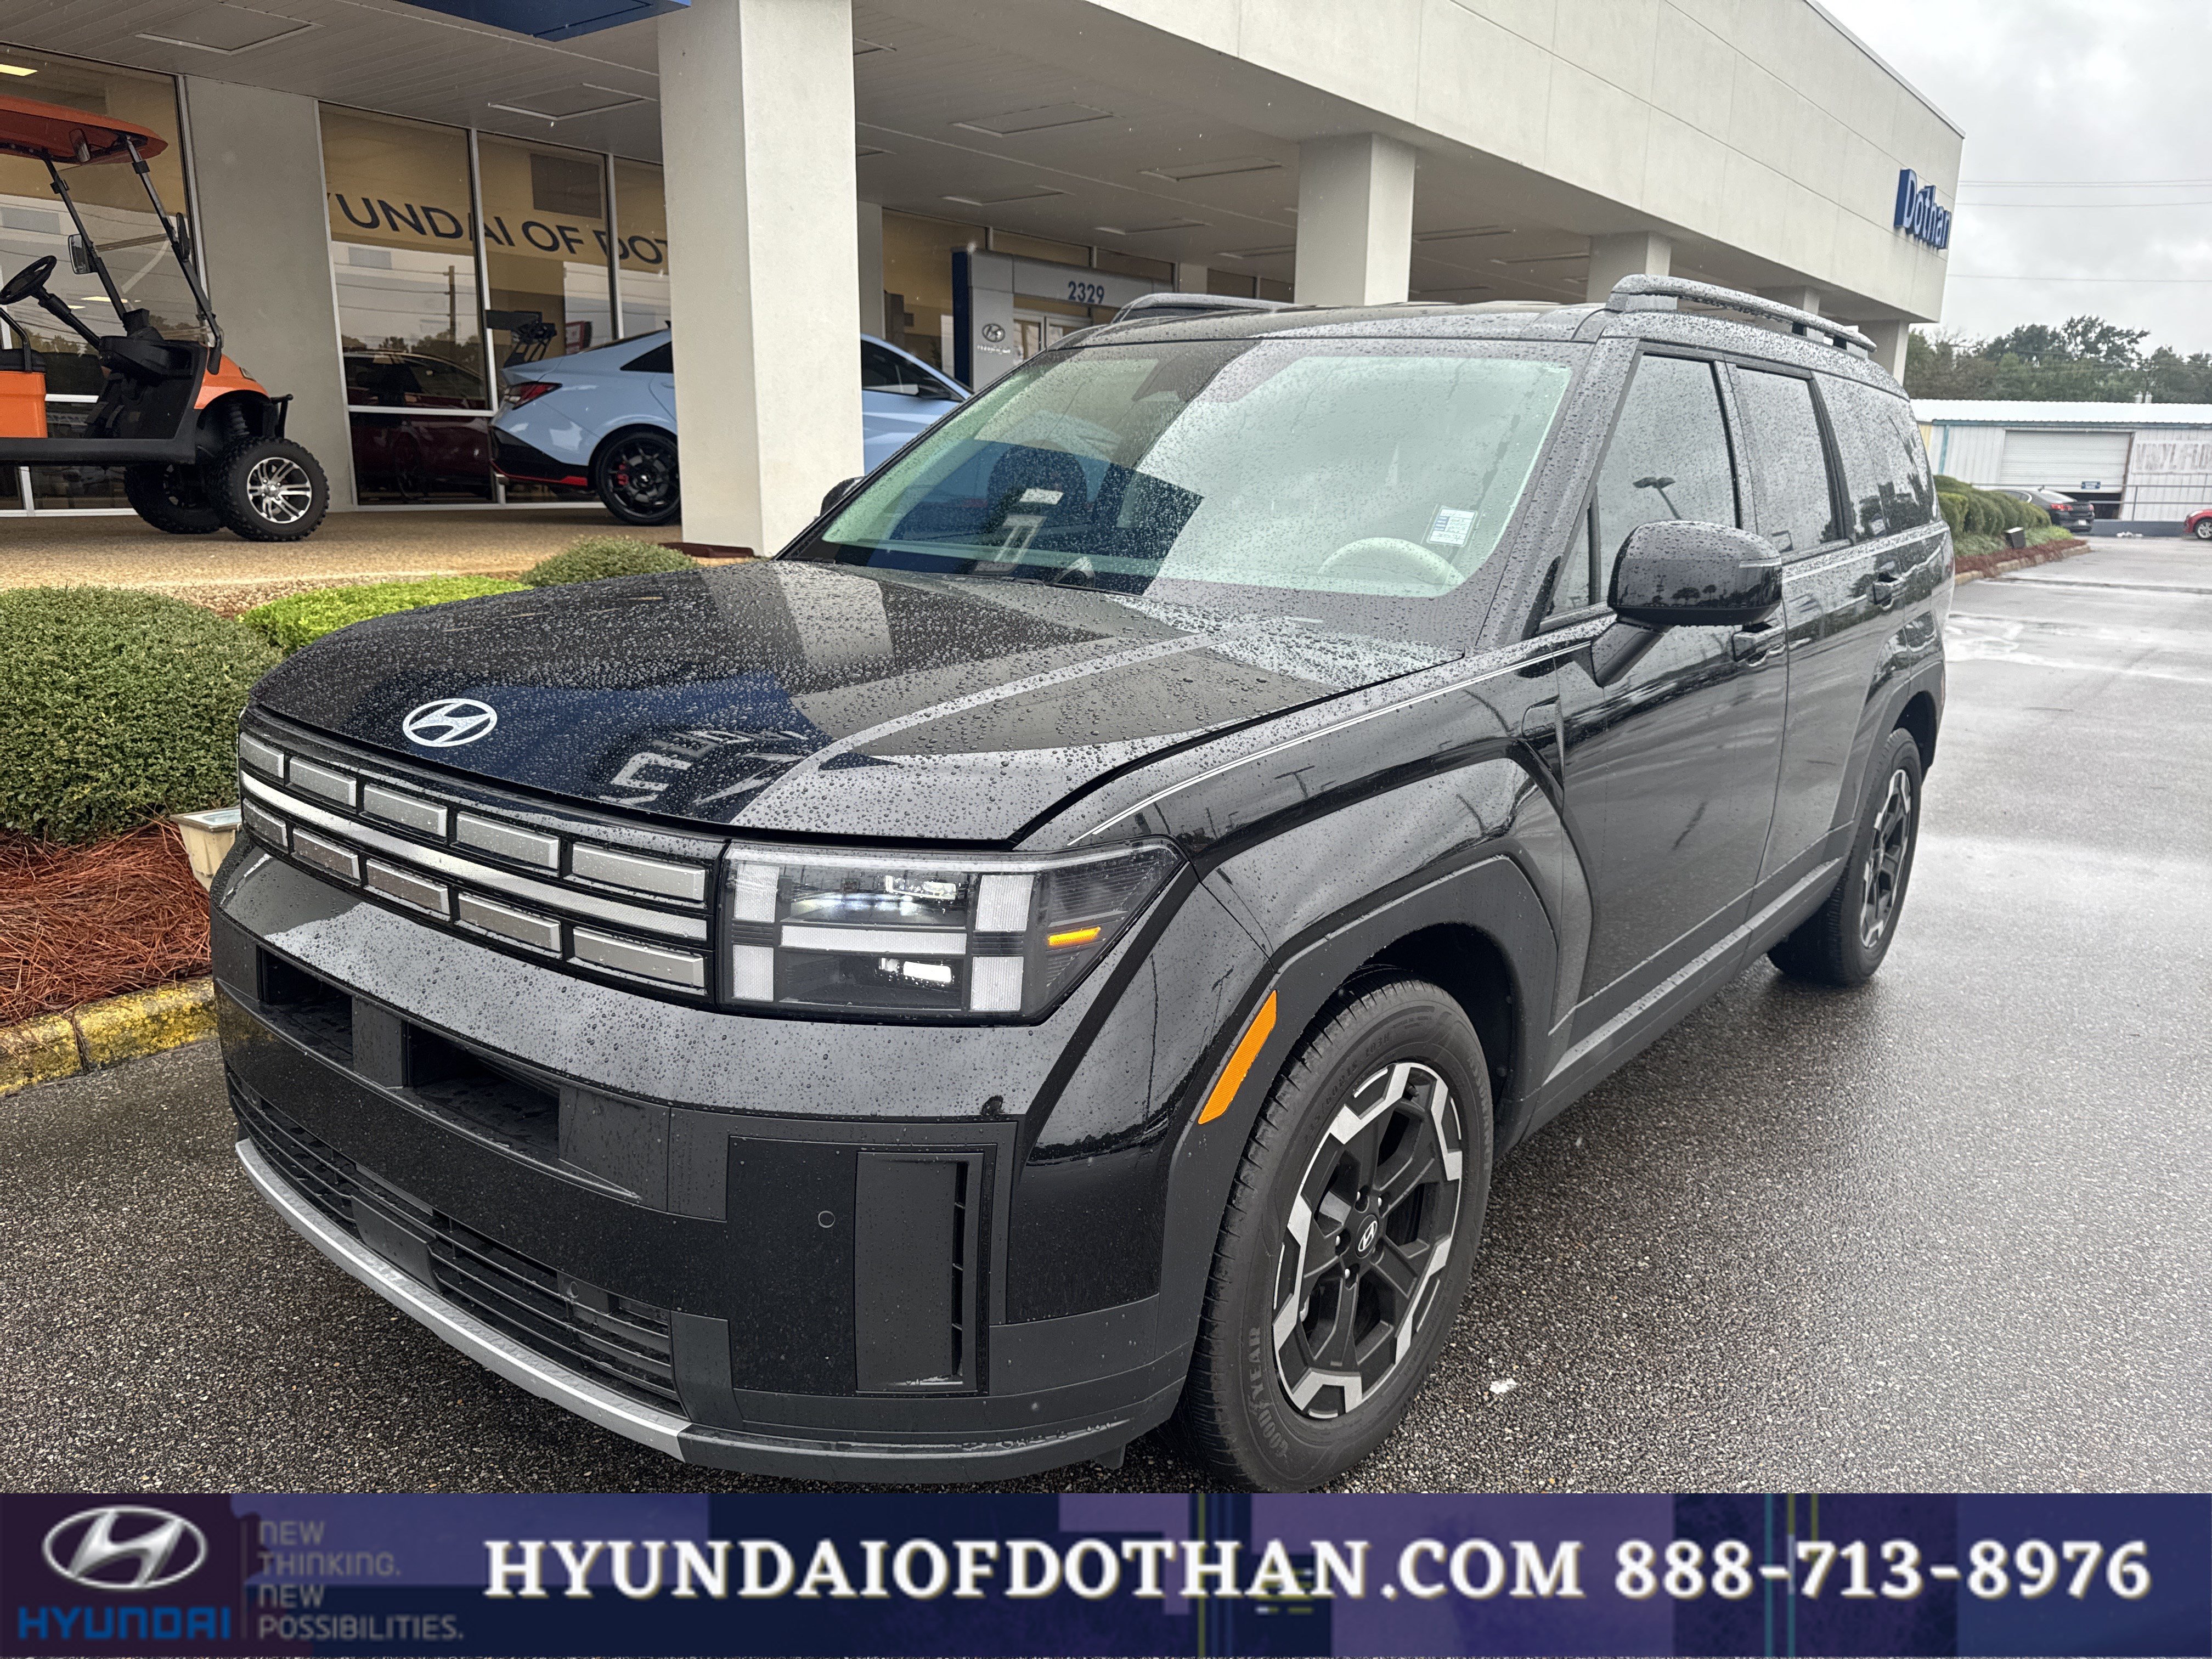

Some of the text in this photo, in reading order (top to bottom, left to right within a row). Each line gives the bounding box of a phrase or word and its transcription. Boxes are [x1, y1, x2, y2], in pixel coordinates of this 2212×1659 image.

[327, 192, 515, 247] UNDAI
[522, 221, 584, 254] OF
[1894, 168, 1952, 249] Dothan
[1068, 280, 1105, 304] 2329
[1249, 1327, 1289, 1458] GOODYEAR
